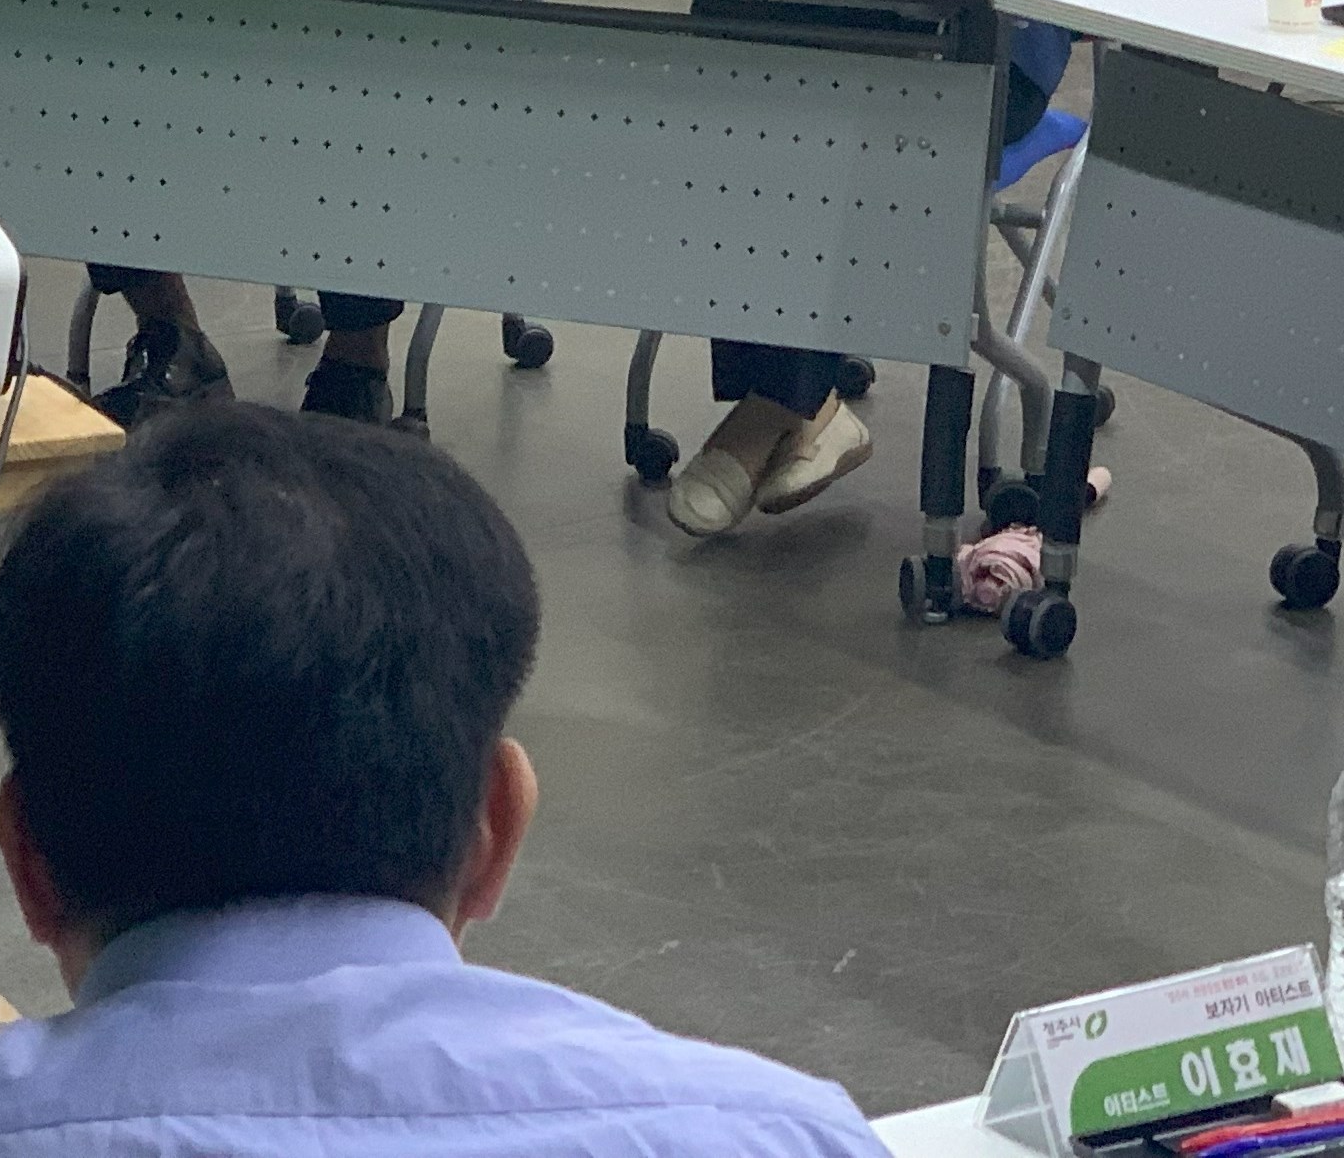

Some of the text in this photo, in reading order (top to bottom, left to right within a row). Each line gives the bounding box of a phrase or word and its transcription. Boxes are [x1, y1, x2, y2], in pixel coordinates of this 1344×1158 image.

[1204, 994, 1251, 1020] 보자기
[1255, 979, 1313, 1009] 아티스트
[1103, 1025, 1312, 1118] 아티스트 이효재
